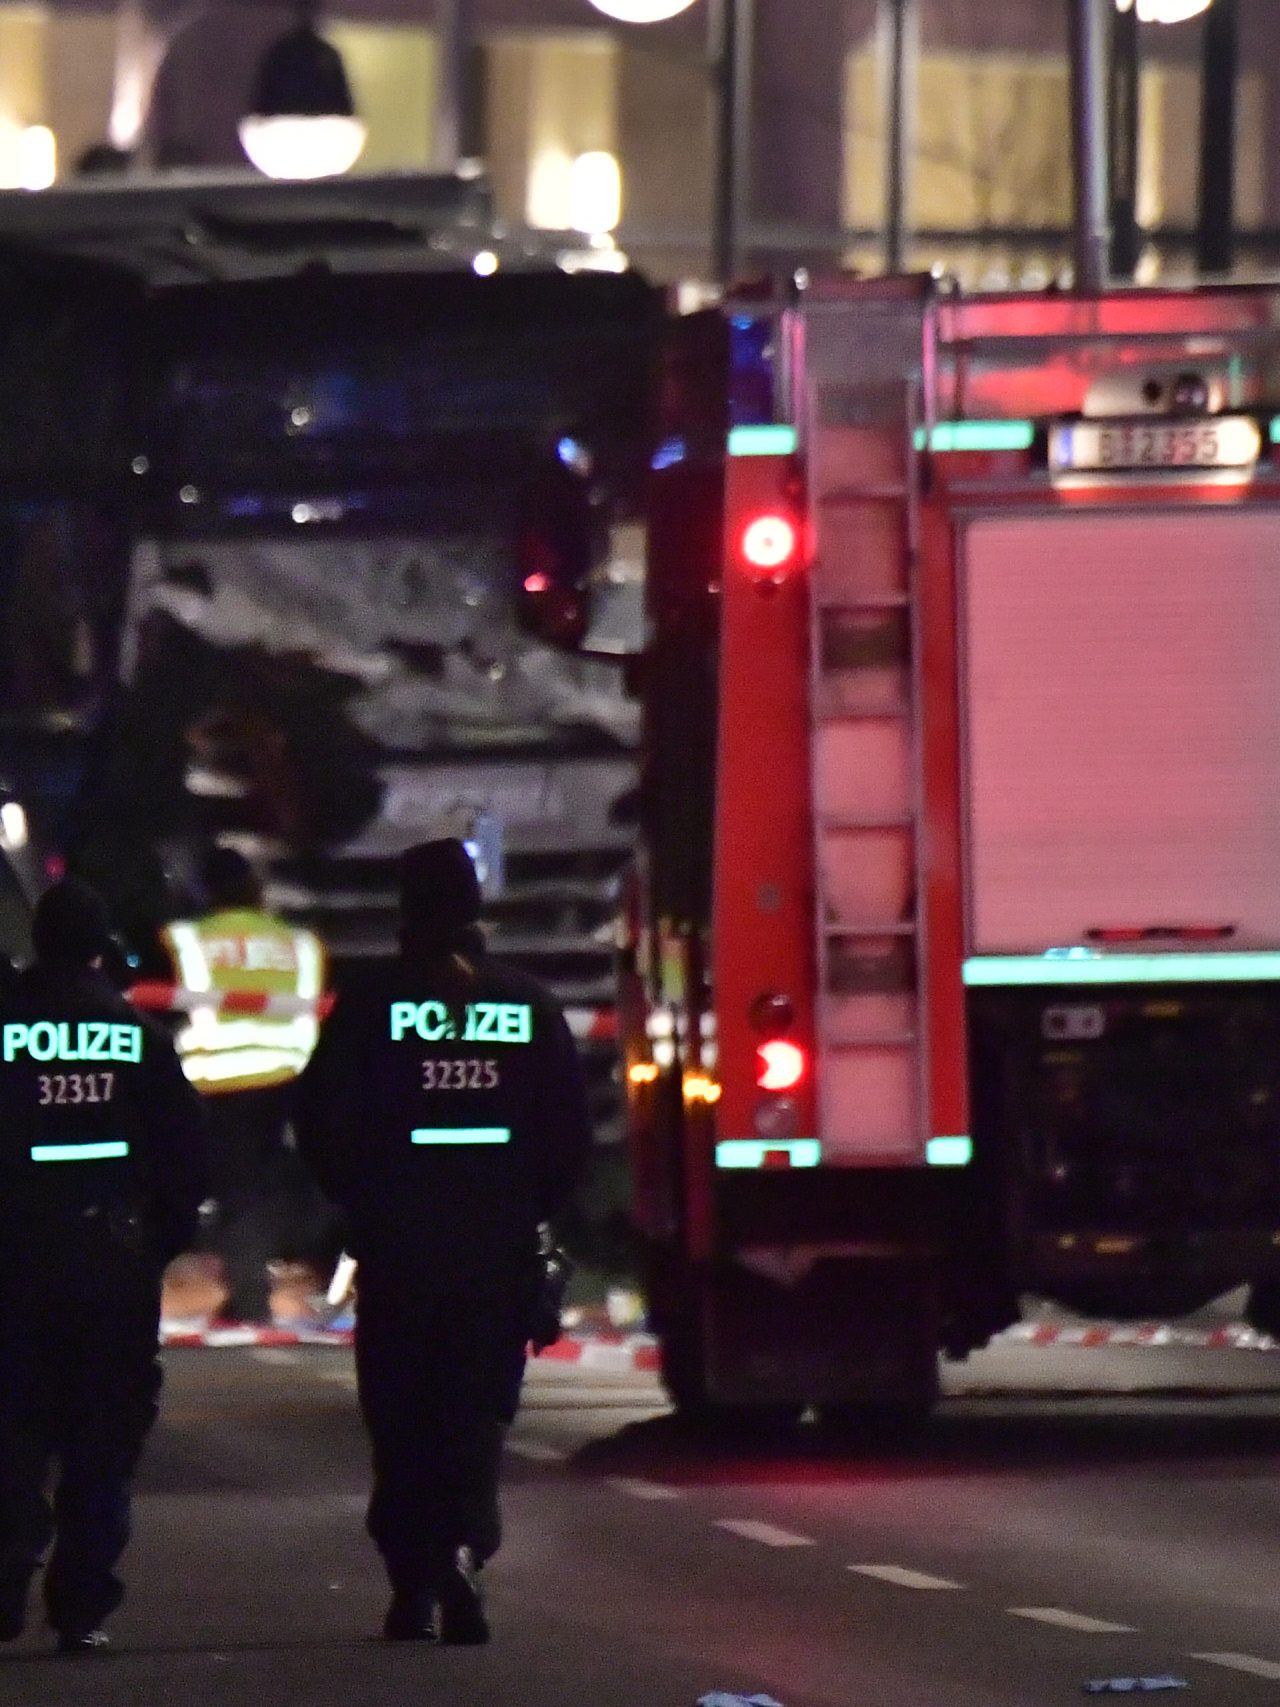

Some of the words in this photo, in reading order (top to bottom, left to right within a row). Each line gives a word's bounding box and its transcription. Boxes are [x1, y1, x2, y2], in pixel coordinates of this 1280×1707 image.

[390, 1000, 533, 1043] POIZEI
[3, 1021, 142, 1063] POLIZEI
[38, 1072, 114, 1105] 32317
[421, 1060, 499, 1090] 32325
